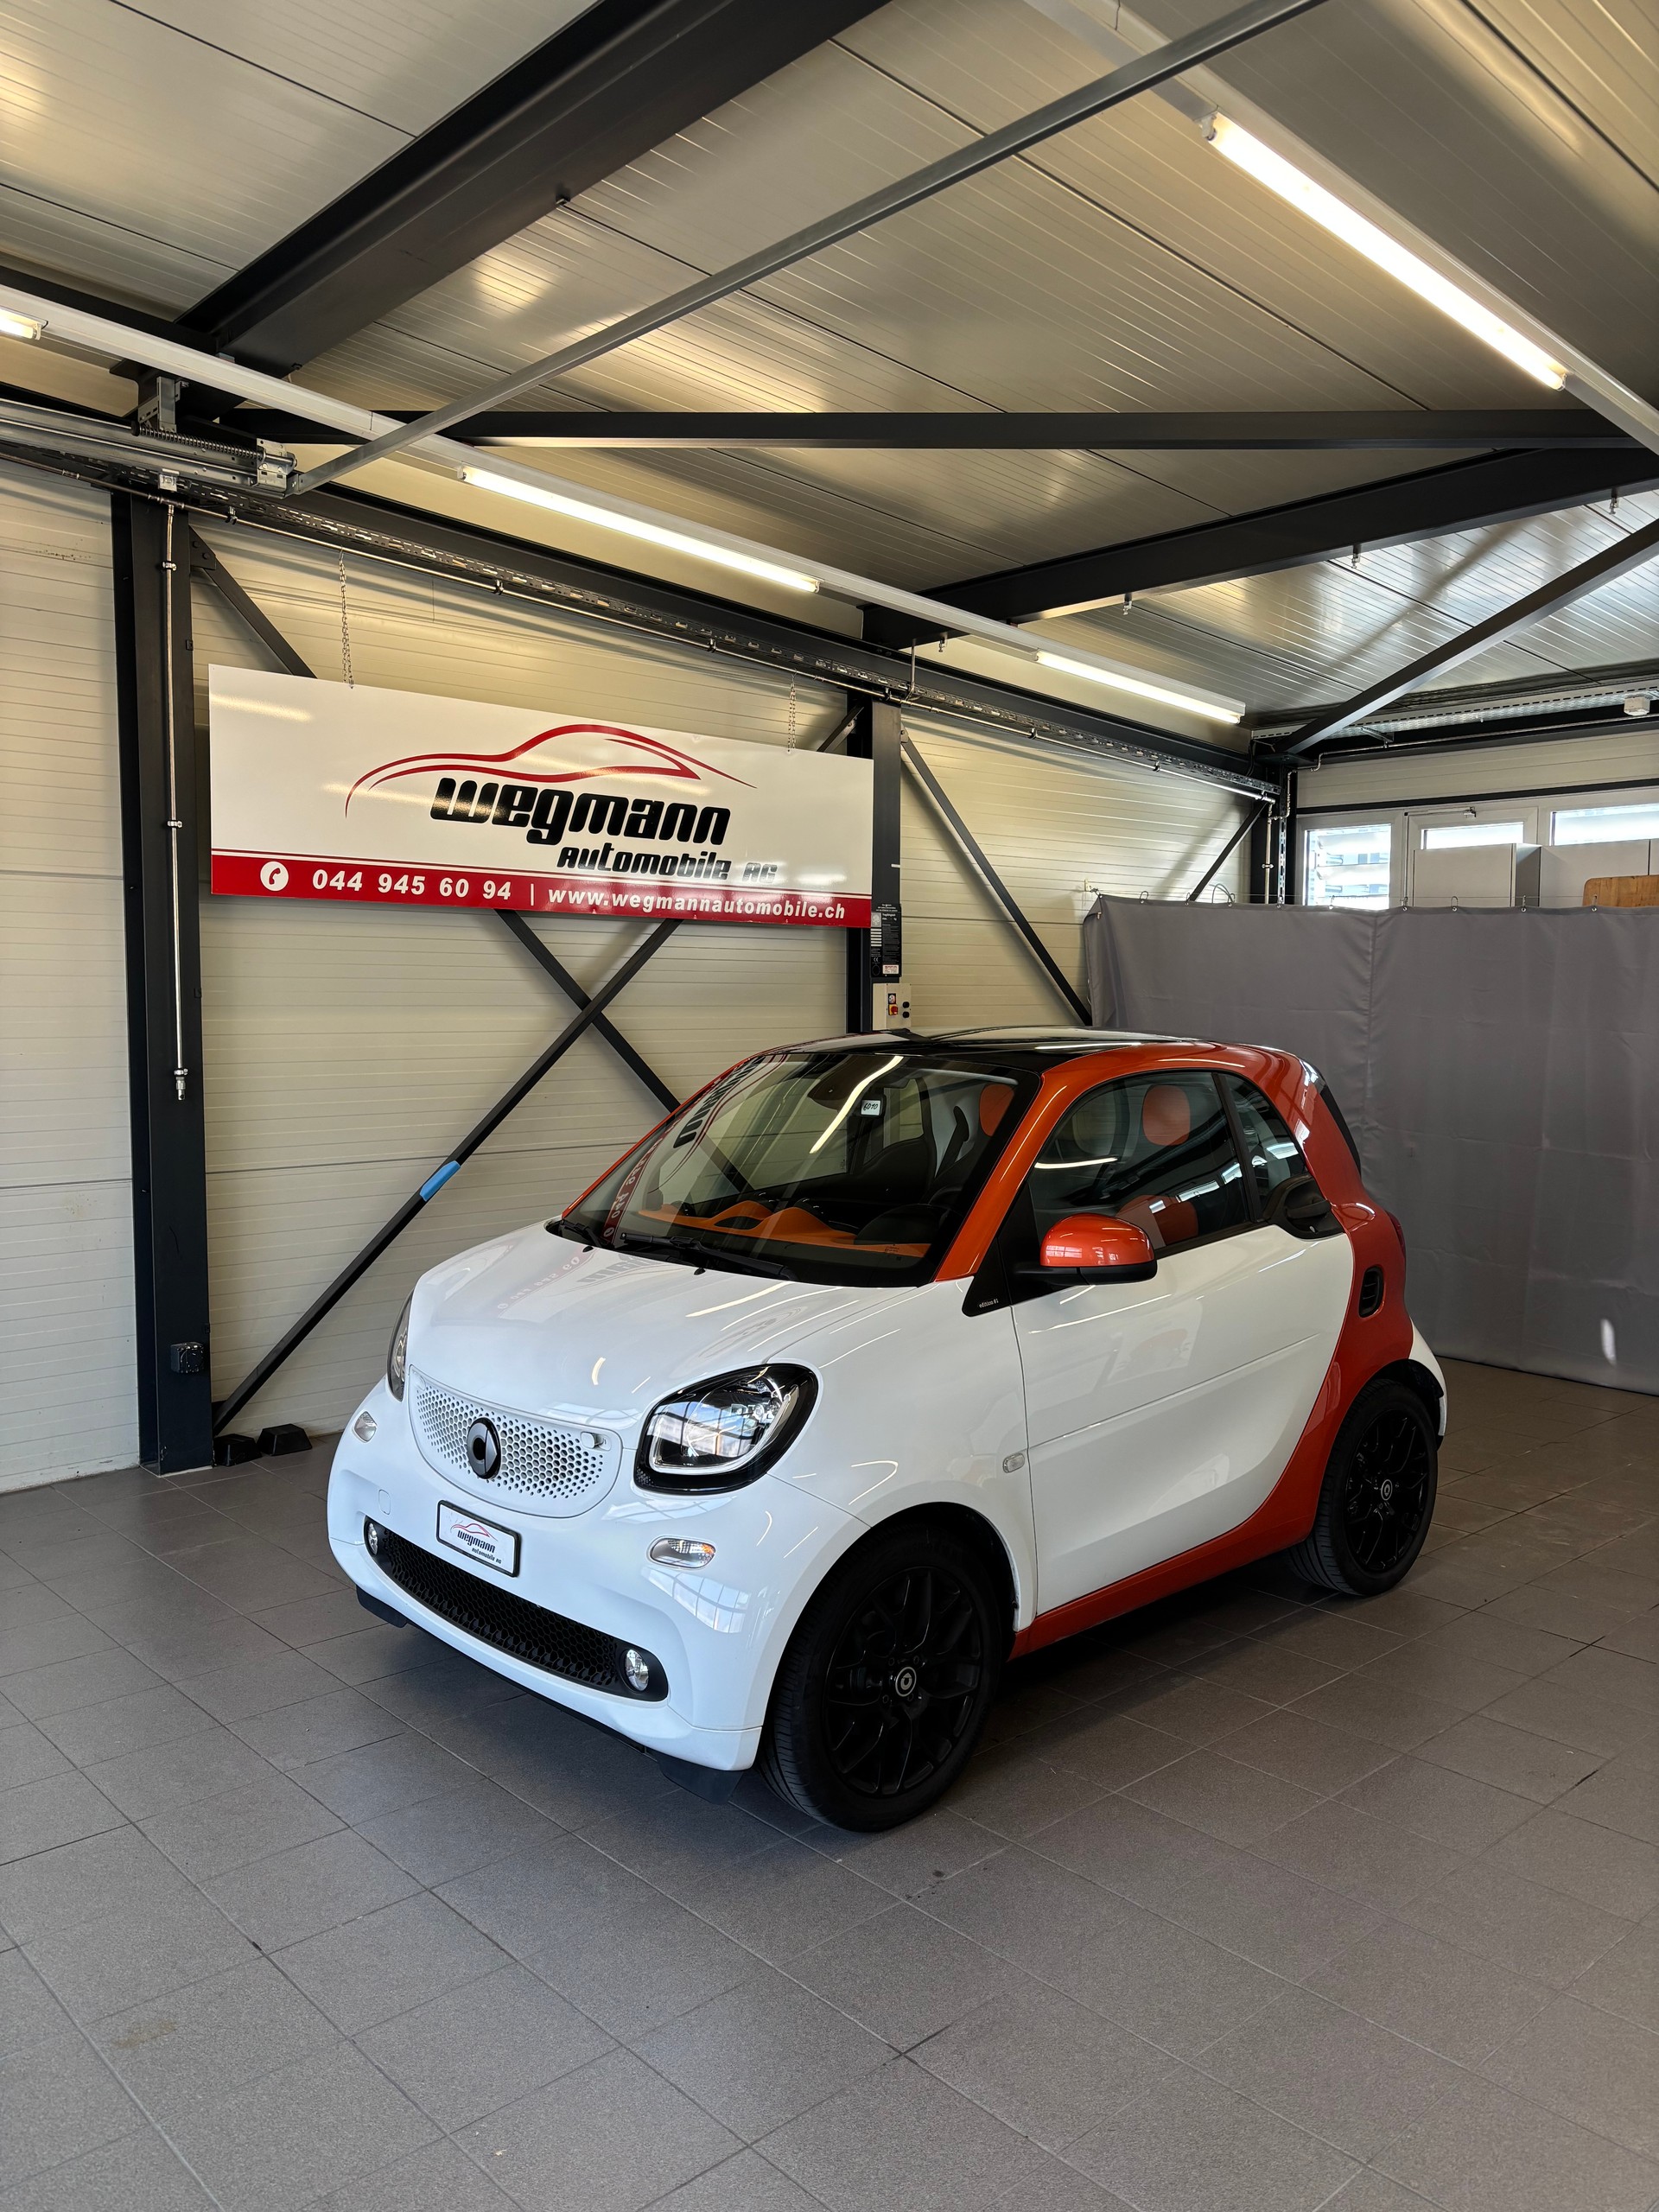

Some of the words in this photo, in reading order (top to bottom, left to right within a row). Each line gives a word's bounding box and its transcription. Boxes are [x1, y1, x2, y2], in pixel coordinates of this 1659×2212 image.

[430, 778, 730, 845] wegmann
[312, 869, 363, 892] 044
[378, 874, 426, 895] 945
[439, 878, 469, 898] 60
[482, 880, 512, 900] 94
[548, 889, 845, 919] www.wegmannautomobile.ch
[742, 862, 778, 884] AG
